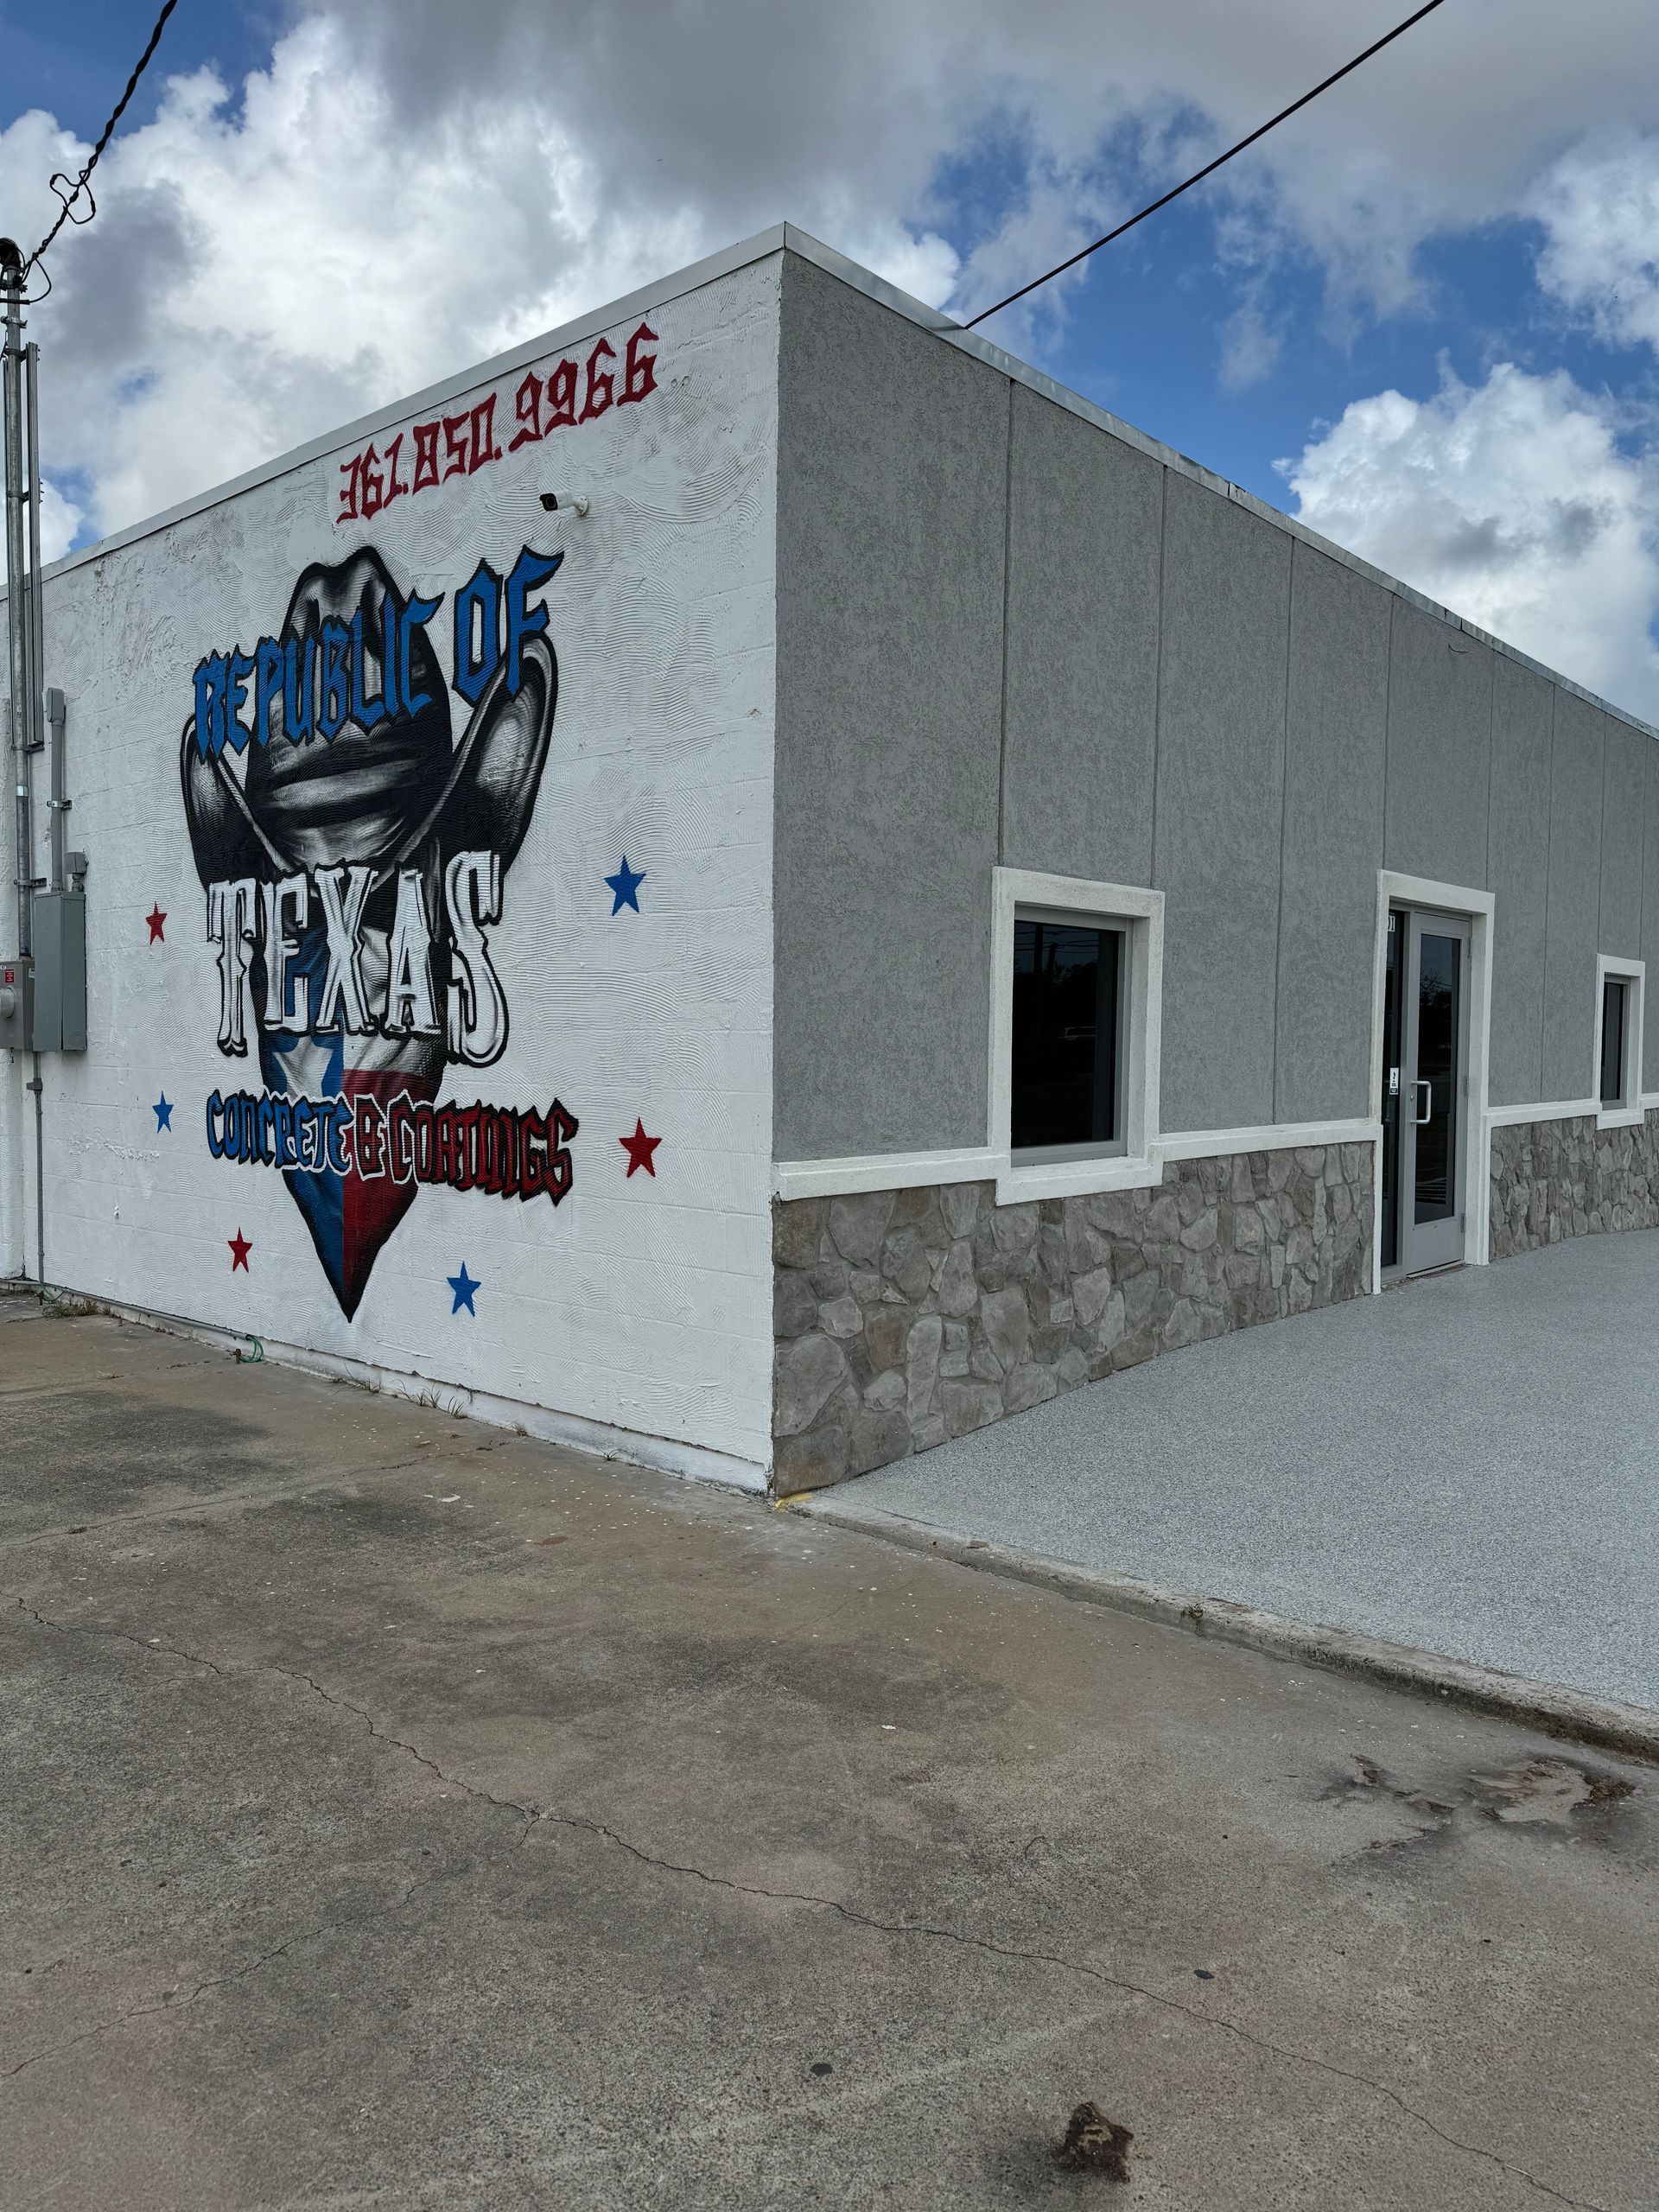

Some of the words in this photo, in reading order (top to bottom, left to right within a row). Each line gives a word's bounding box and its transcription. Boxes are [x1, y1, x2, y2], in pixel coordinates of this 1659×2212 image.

[336, 322, 659, 524] 361.850.9966
[193, 588, 445, 765] REPUBLIC
[452, 544, 565, 707] OF
[207, 849, 510, 1068] TEXAS
[207, 1088, 354, 1176] CONCRETE
[388, 1089, 580, 1207] COATINGS
